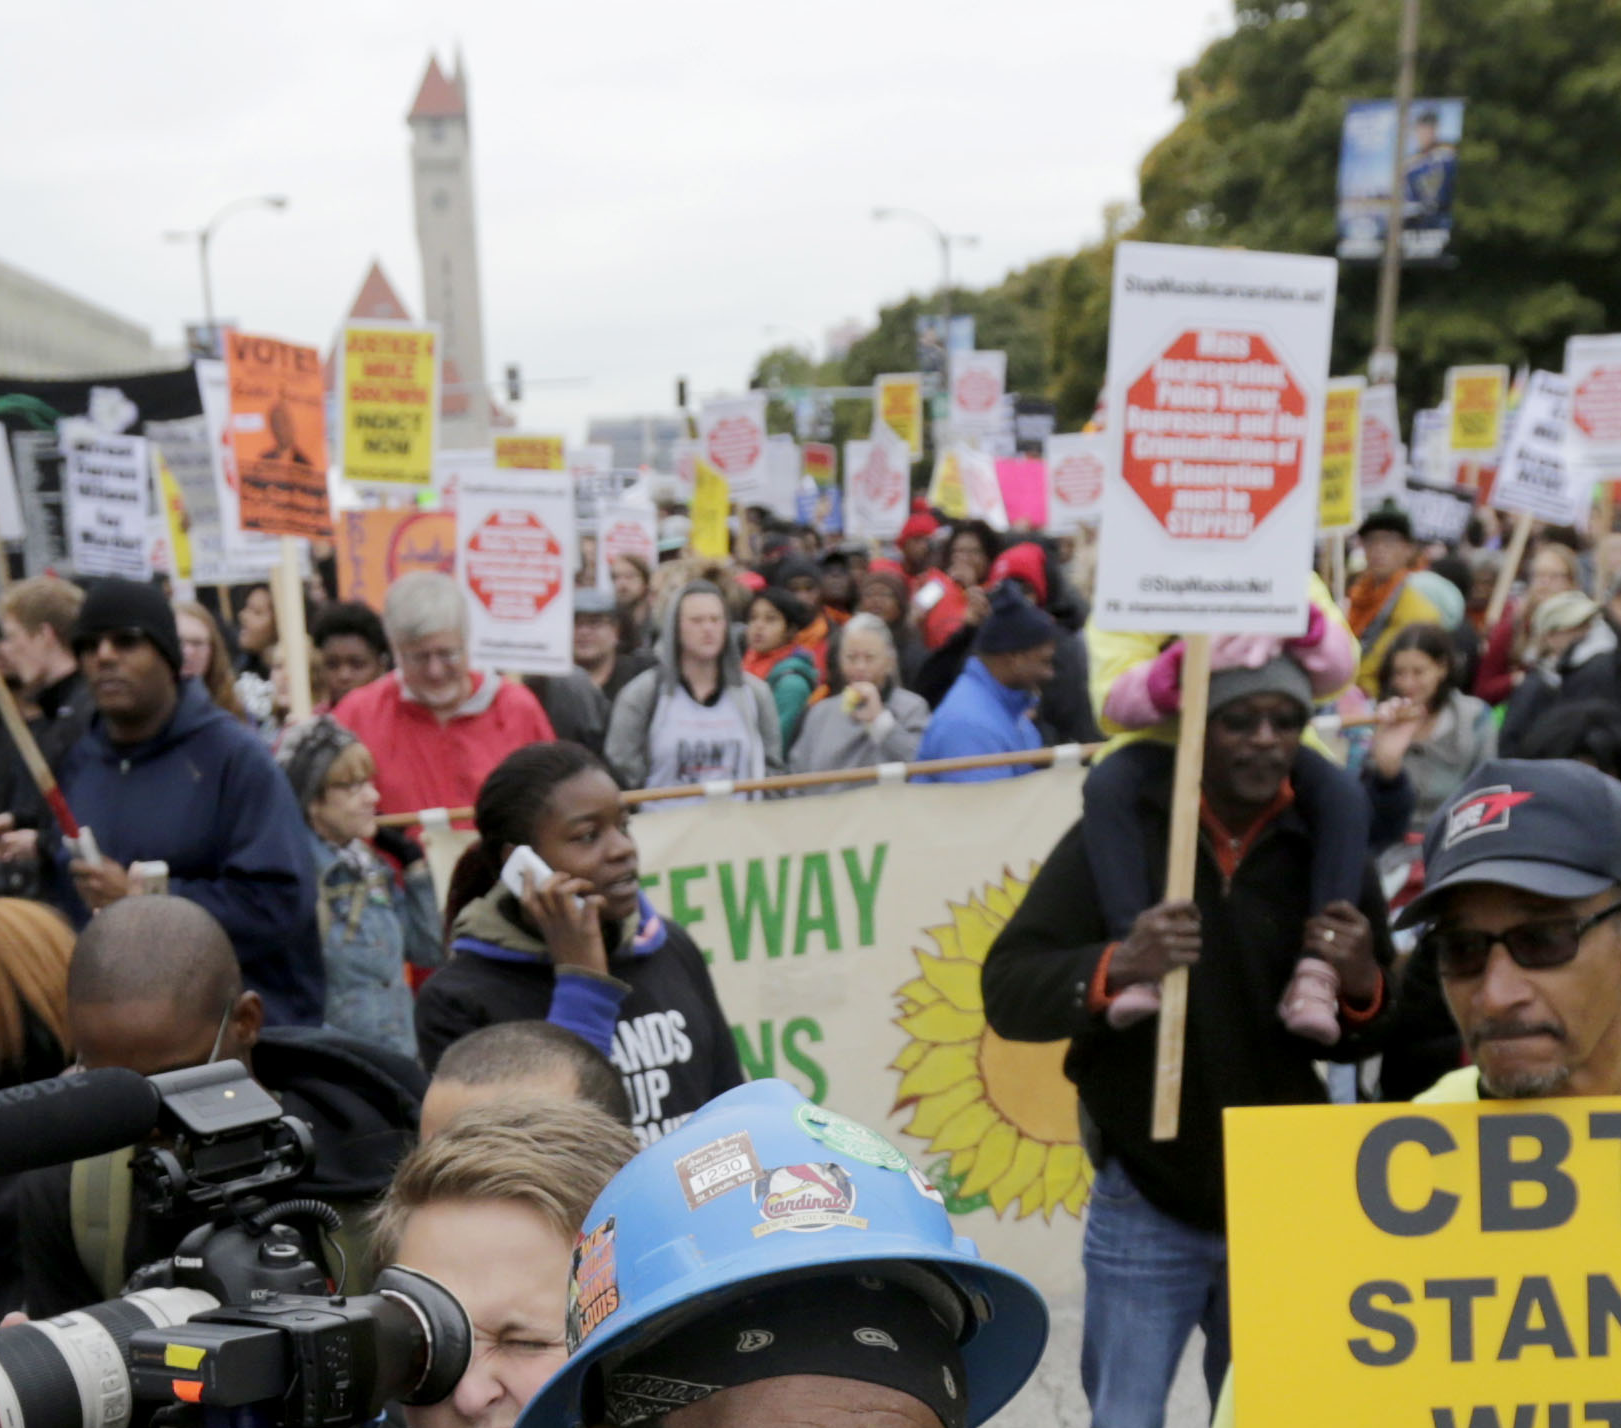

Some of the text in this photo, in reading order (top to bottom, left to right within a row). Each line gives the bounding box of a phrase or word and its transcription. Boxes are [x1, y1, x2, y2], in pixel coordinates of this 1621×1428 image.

[1197, 330, 1251, 358] Mass
[1157, 381, 1219, 411] Police
[1126, 404, 1309, 438] Repression and the
[1132, 432, 1298, 465] Criminalization of
[1151, 460, 1275, 490] a Generation
[1173, 488, 1251, 512] must be
[622, 1068, 671, 1124] UP
[697, 1158, 743, 1189] 1230
[737, 1171, 756, 1184] MO
[763, 1192, 851, 1220] Cardinals
[174, 1255, 204, 1269] Canon
[580, 1285, 619, 1341] LOUIS
